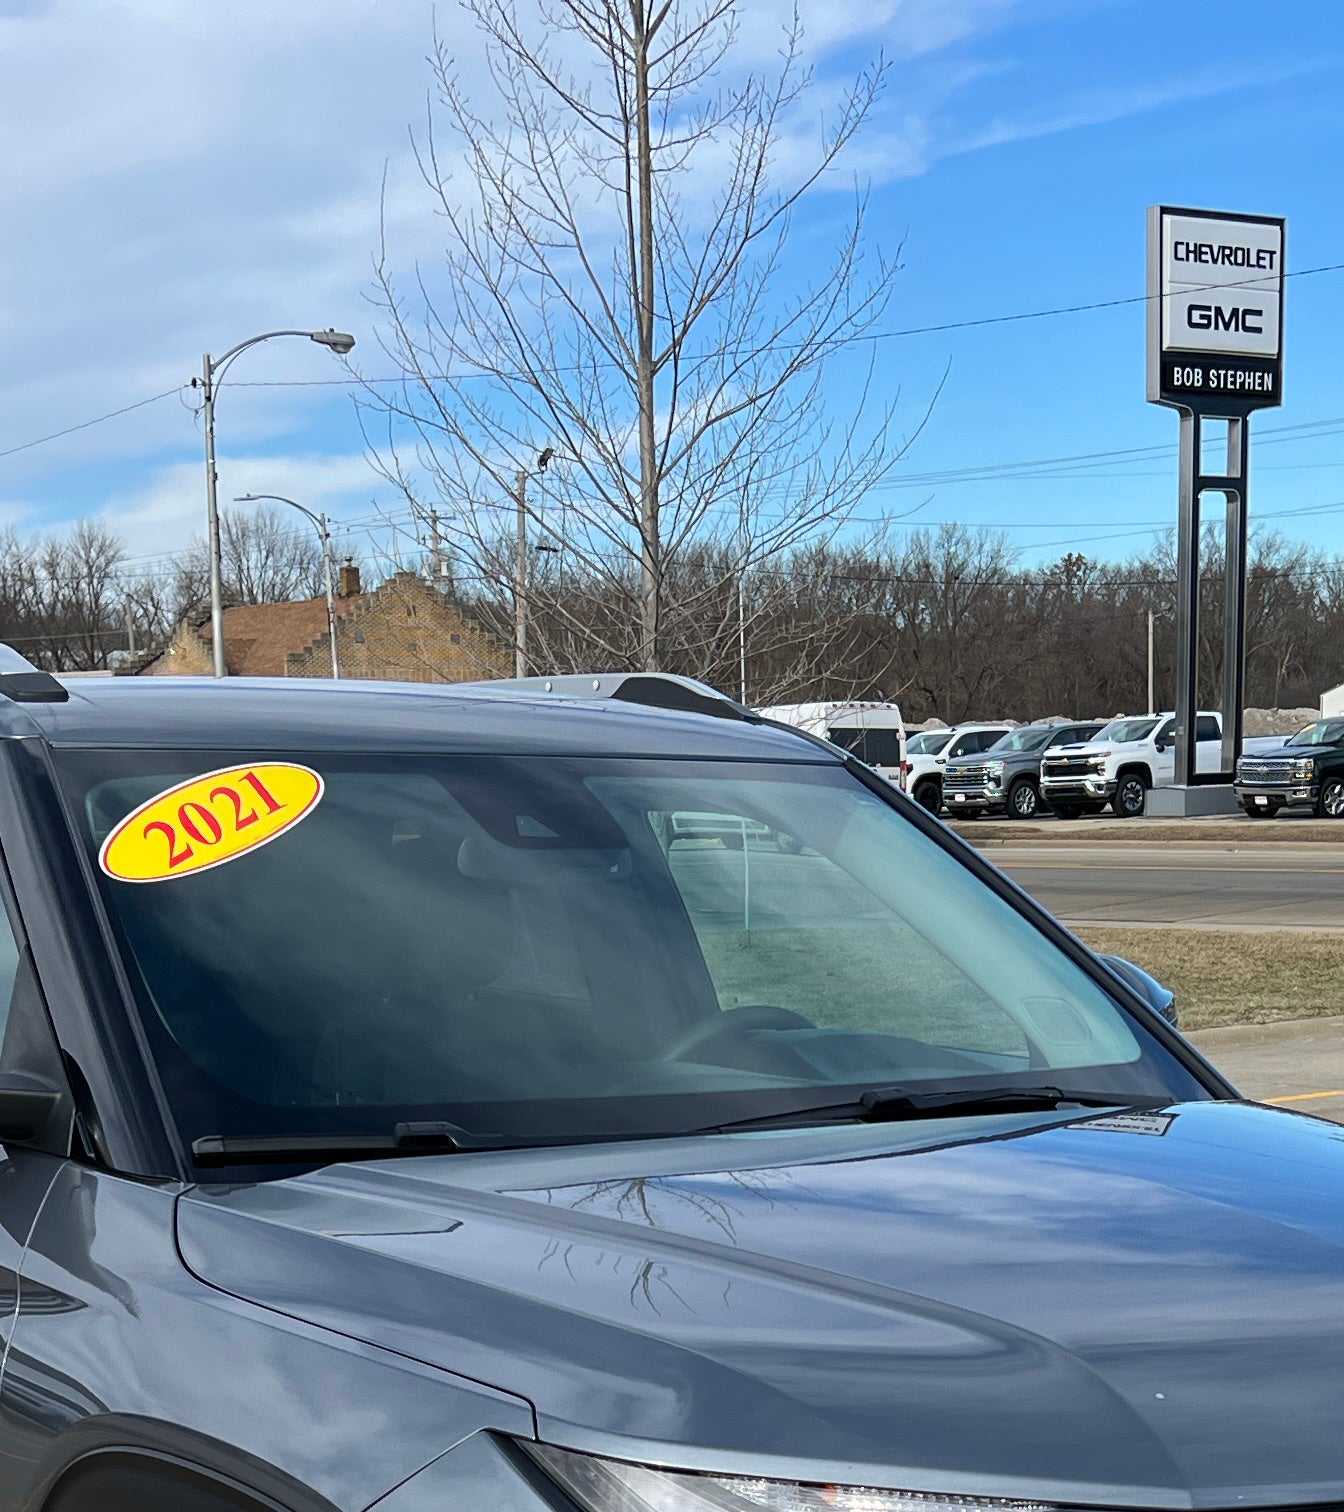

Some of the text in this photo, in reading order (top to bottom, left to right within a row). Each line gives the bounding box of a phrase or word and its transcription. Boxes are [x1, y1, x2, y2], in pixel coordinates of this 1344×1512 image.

[1173, 240, 1277, 270] CHEVROLET
[1187, 303, 1263, 334] GMC
[1173, 367, 1273, 392] BOB STEPHEN
[143, 770, 288, 869] 2021
